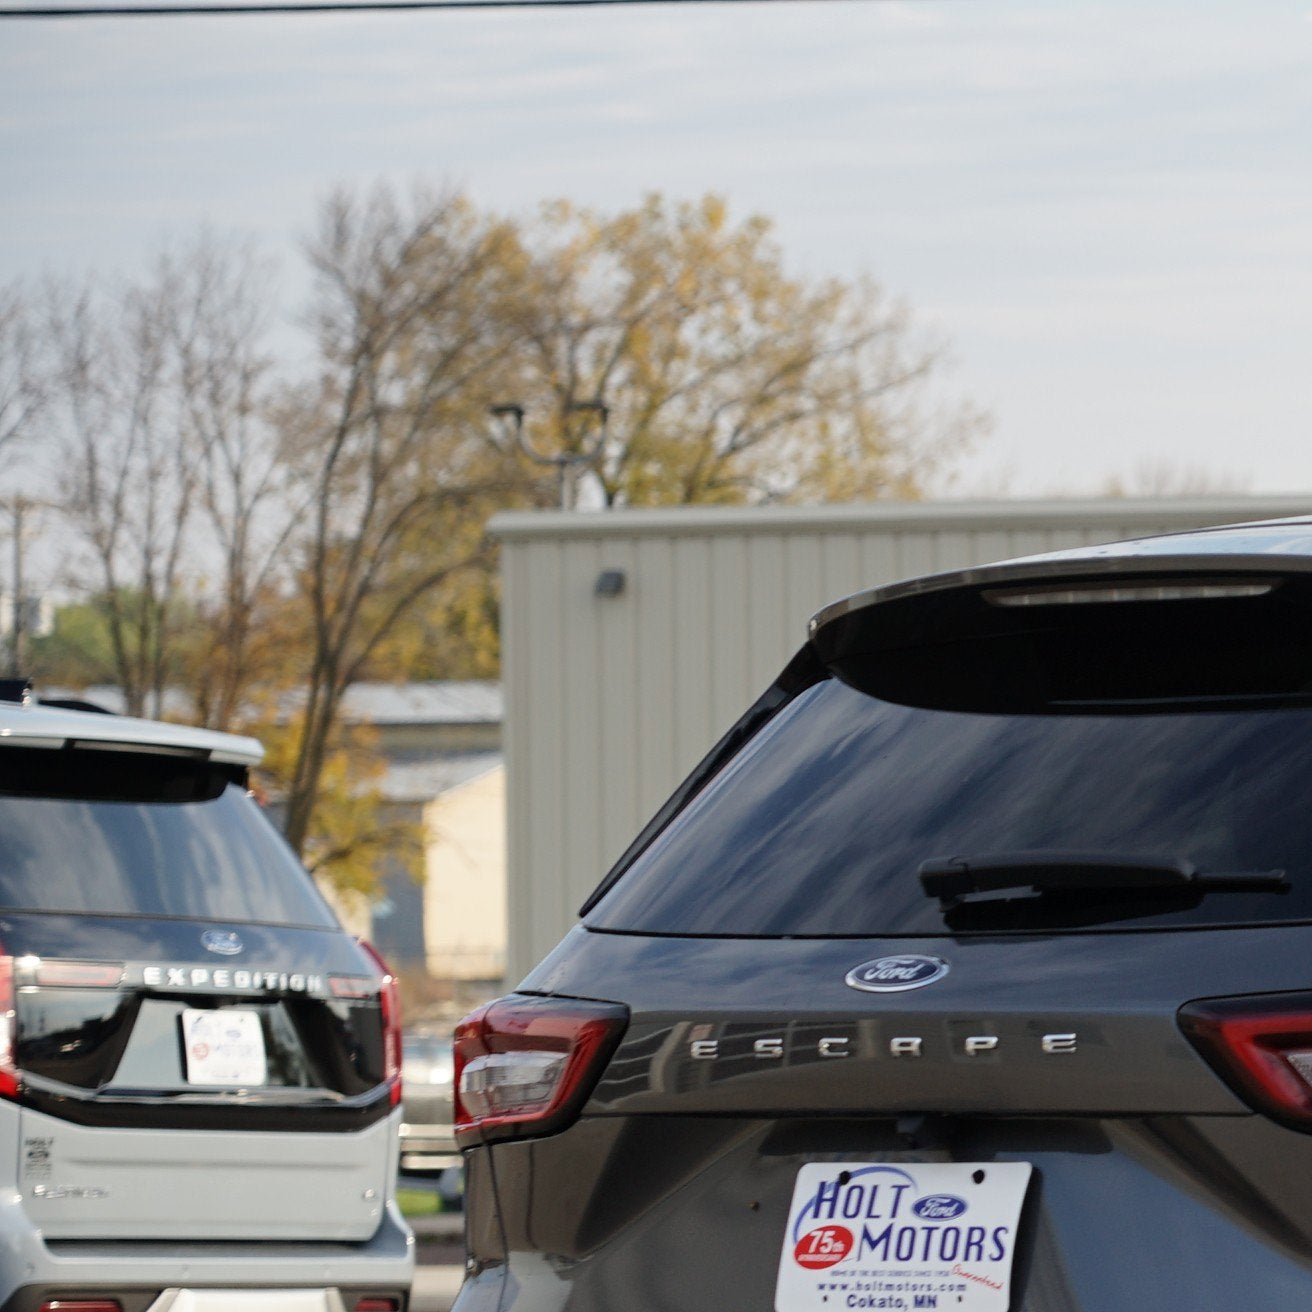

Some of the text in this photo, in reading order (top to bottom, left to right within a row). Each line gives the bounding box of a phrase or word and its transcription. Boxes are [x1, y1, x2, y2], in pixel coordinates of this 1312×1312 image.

[142, 966, 323, 992] EXPEDITION
[690, 1032, 1078, 1061] ESCAPE
[811, 1181, 912, 1219] HOLT
[857, 1223, 1009, 1262] MOTORS
[817, 1281, 967, 1292] www.holtmotors.com
[846, 1294, 938, 1311] Cokato, MN
